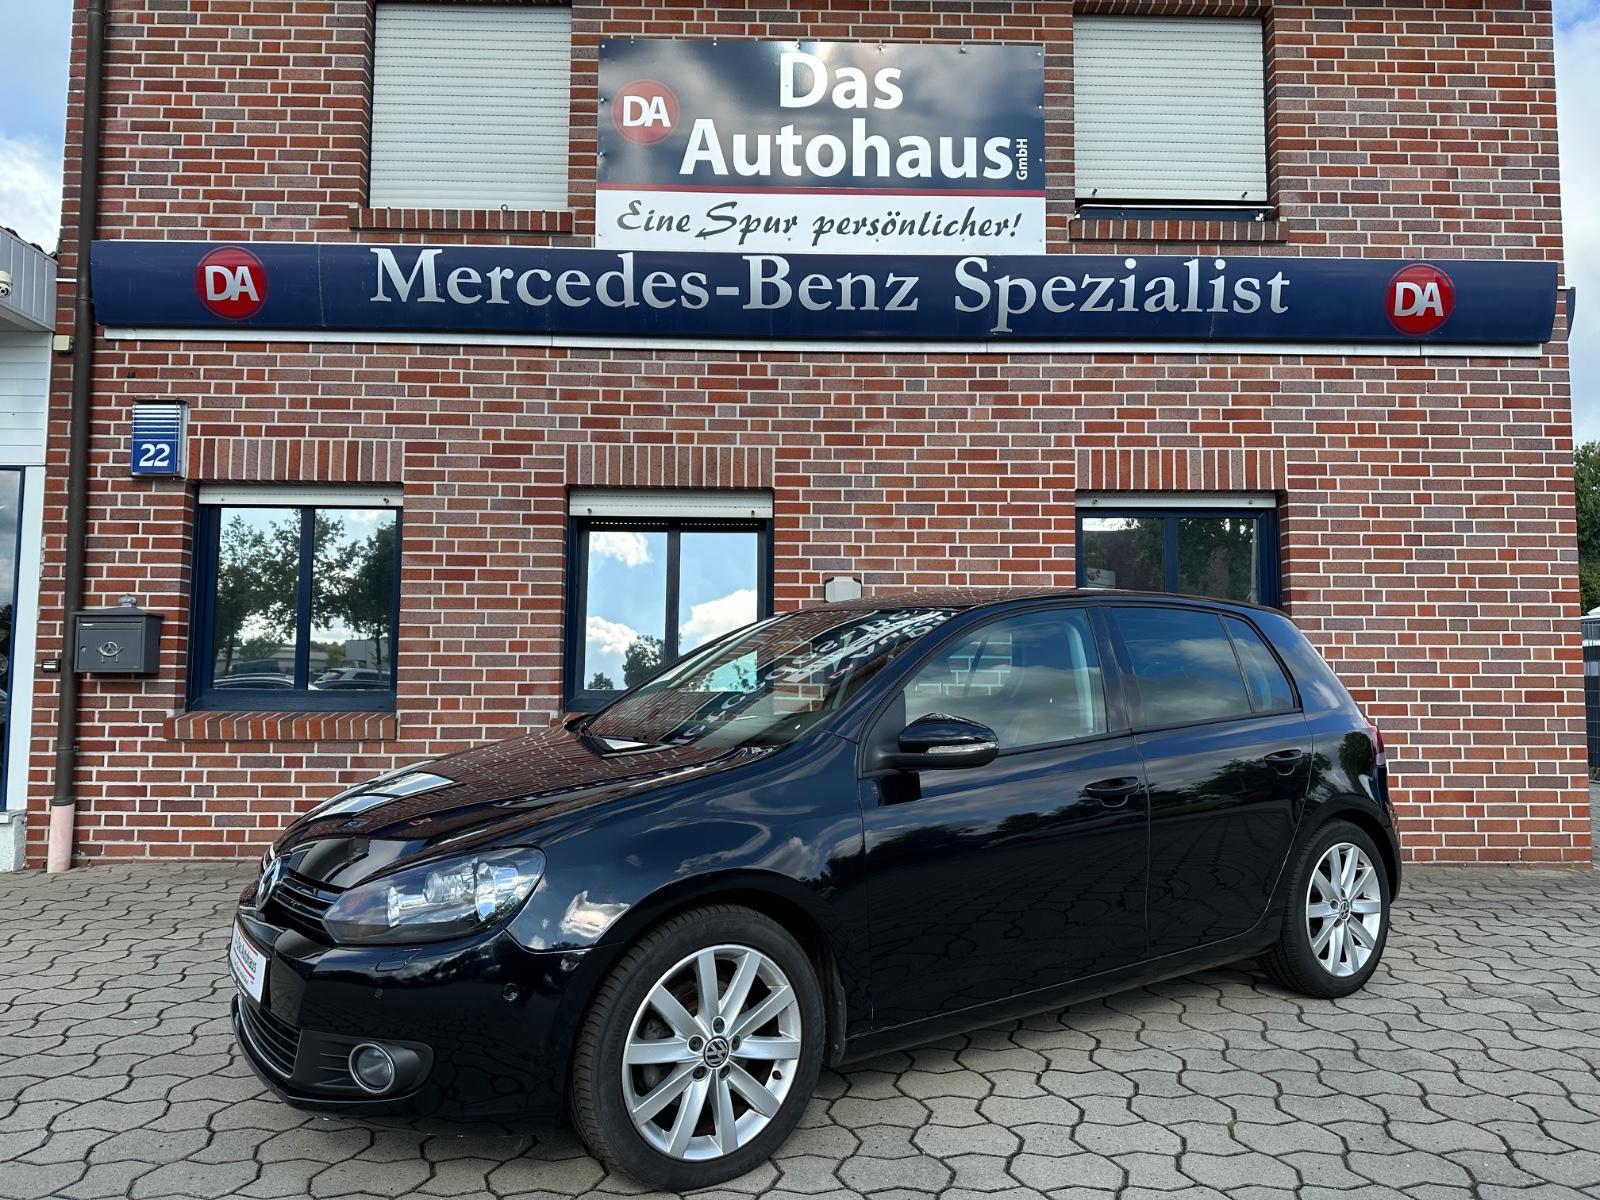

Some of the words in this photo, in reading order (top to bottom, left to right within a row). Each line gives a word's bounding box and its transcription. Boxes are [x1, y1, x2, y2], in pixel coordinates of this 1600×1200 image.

[779, 52, 904, 110] Das
[622, 95, 672, 128] DA
[678, 118, 1014, 180] Autohaus
[1015, 138, 1028, 181] GmbH
[616, 199, 691, 233] Eine
[694, 200, 798, 246] Spur
[811, 206, 1023, 247] persönlicher!
[205, 265, 260, 301] DA
[369, 247, 919, 311] Mercedes-Benz
[954, 256, 1291, 333] Spezialist
[1393, 281, 1445, 317] DA
[138, 443, 170, 467] 22
